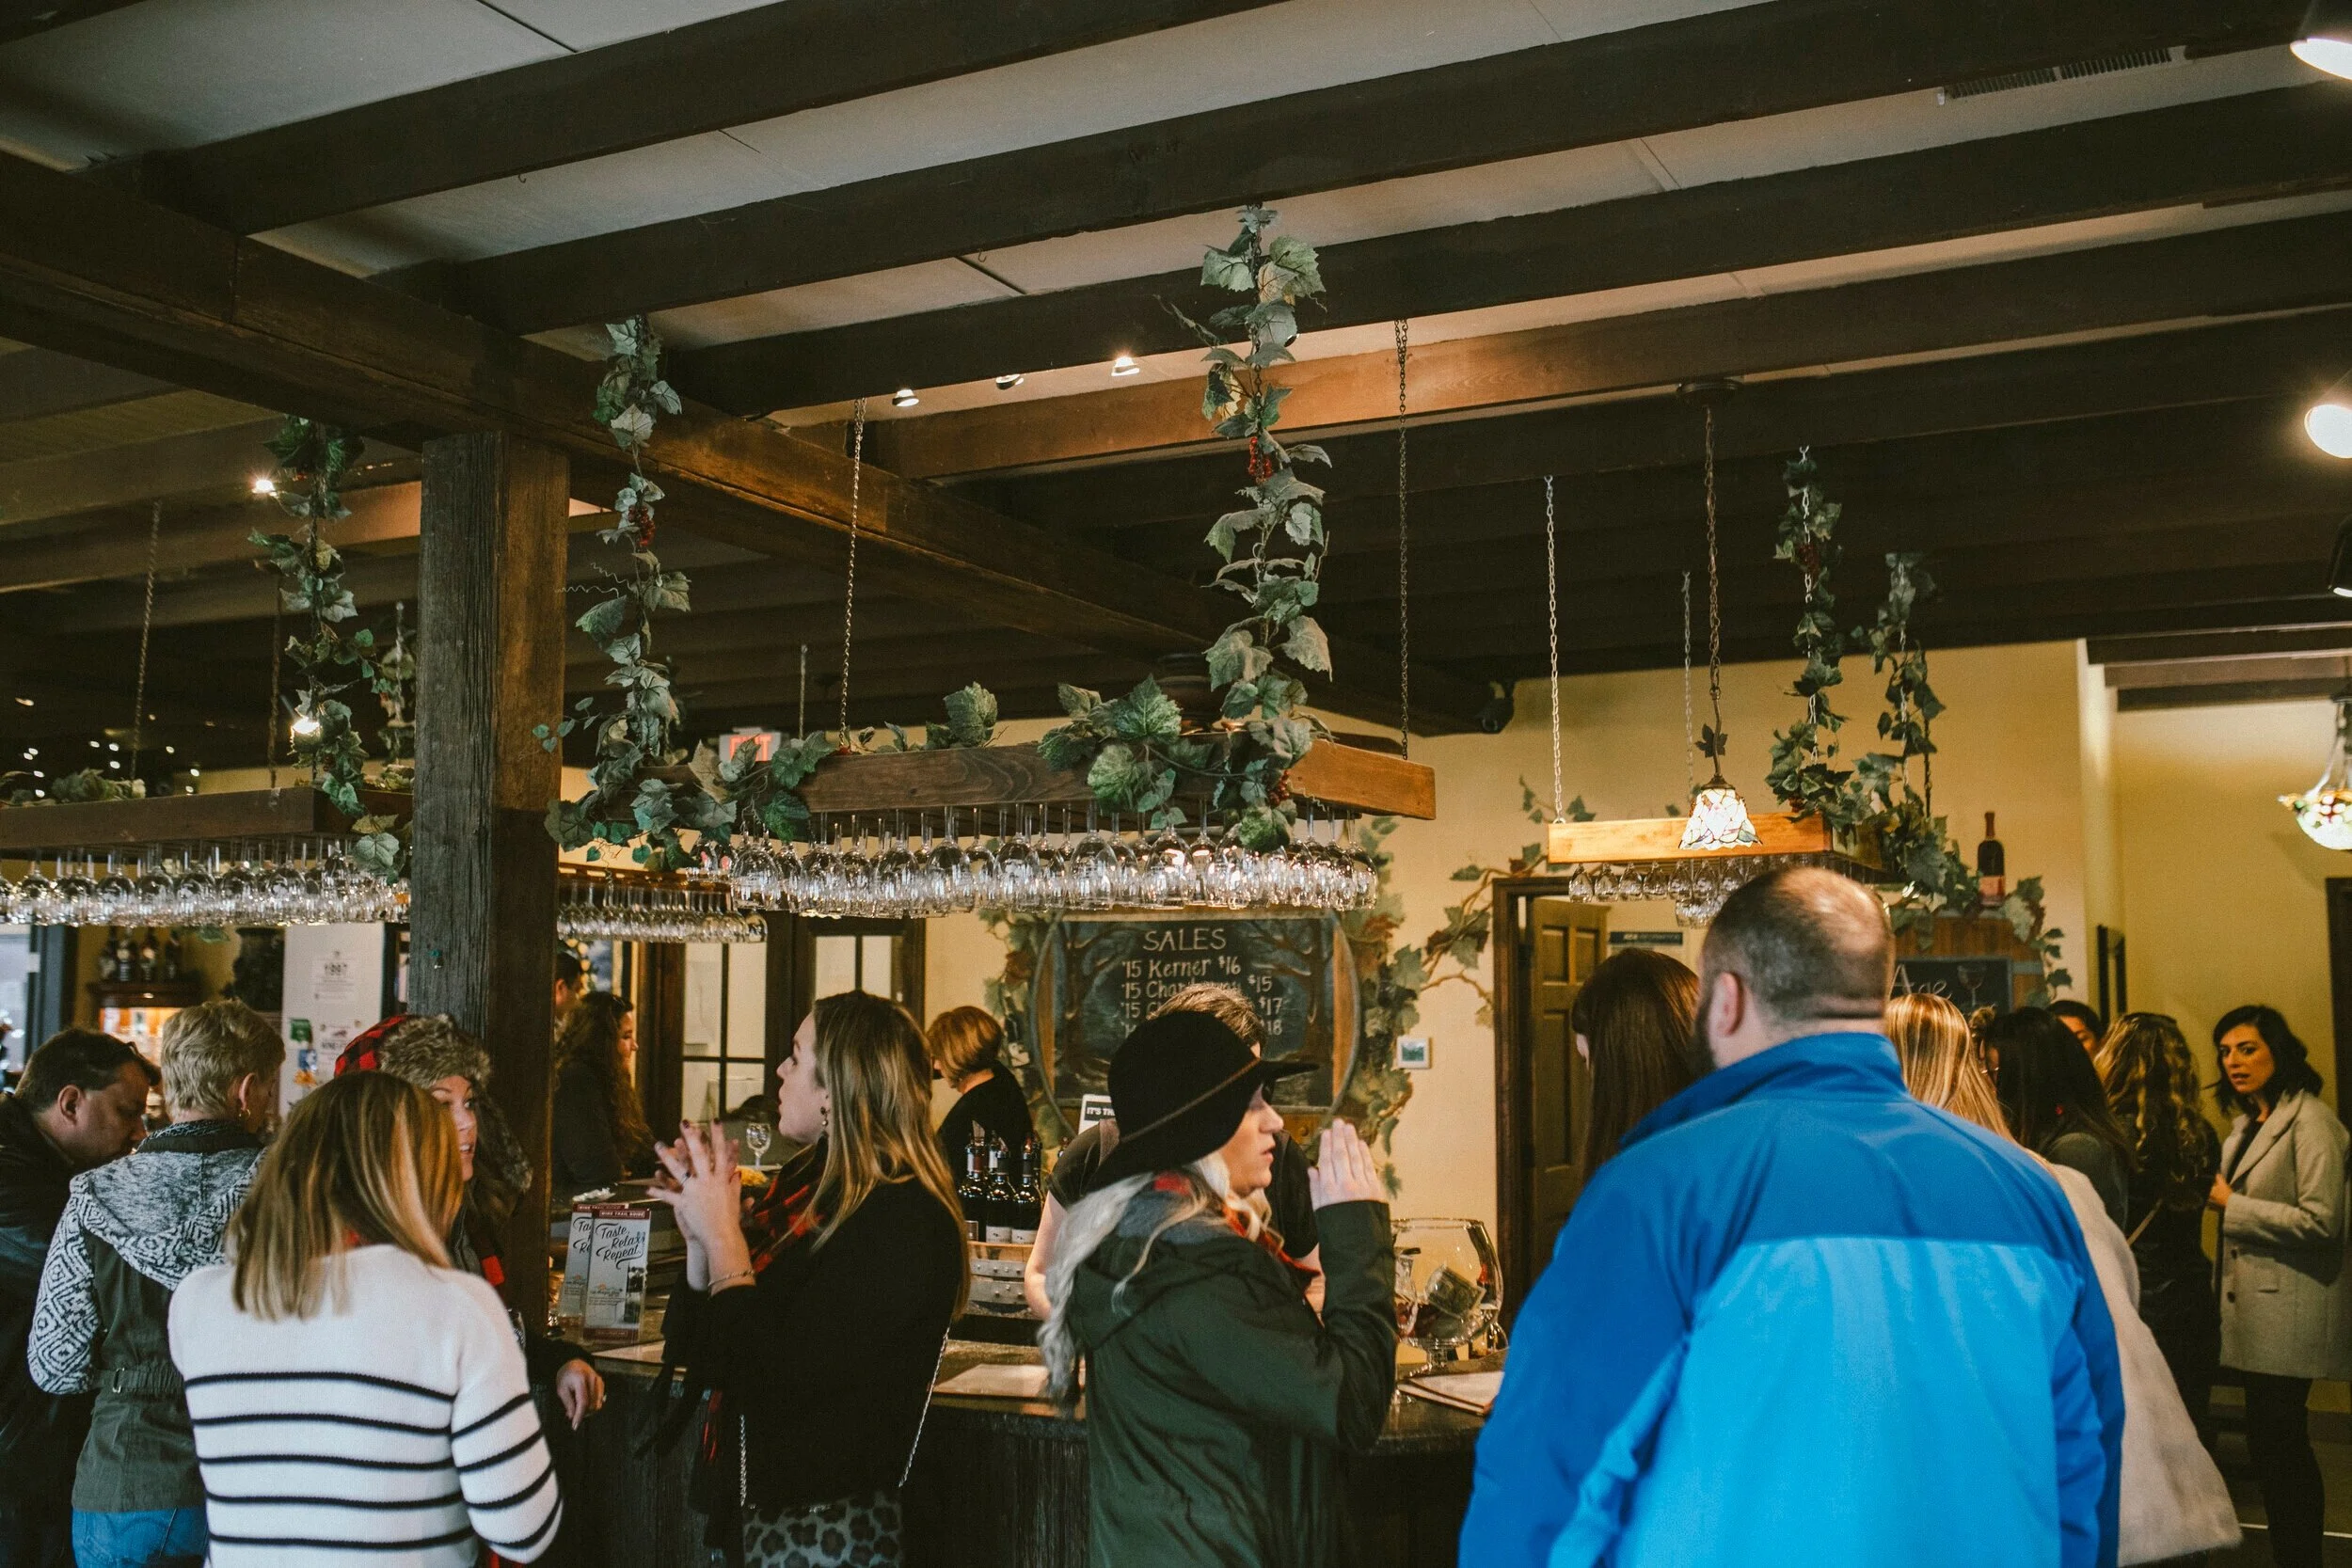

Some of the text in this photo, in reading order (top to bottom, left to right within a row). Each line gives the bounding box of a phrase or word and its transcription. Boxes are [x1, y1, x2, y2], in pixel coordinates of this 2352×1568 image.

[1142, 927, 1227, 952] SALES
[1148, 958, 1212, 979] Kerner
[1218, 955, 1242, 975] $16
[1247, 974, 1274, 994] $15
[1258, 995, 1283, 1017] $17
[1086, 1106, 1102, 1116] IT'S
